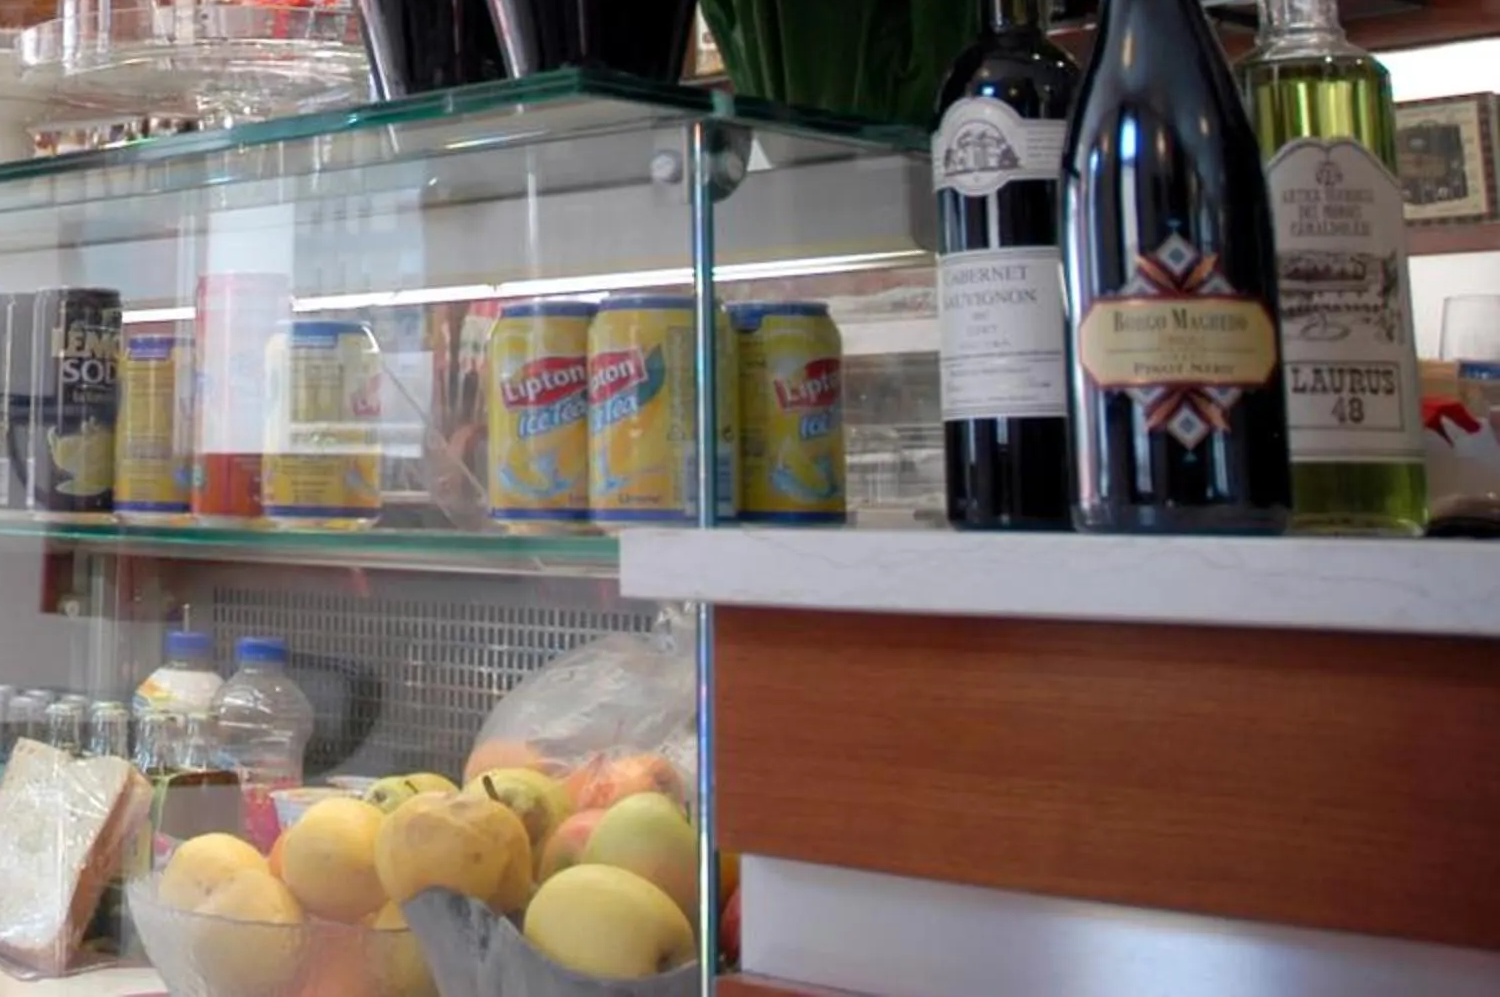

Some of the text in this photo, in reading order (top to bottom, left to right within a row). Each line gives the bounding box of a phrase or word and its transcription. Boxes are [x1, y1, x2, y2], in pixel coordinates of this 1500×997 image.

[62, 358, 118, 384] SOD
[504, 364, 586, 401] Lipton
[1291, 367, 1396, 395] LAURUS
[1331, 396, 1364, 424] 48
